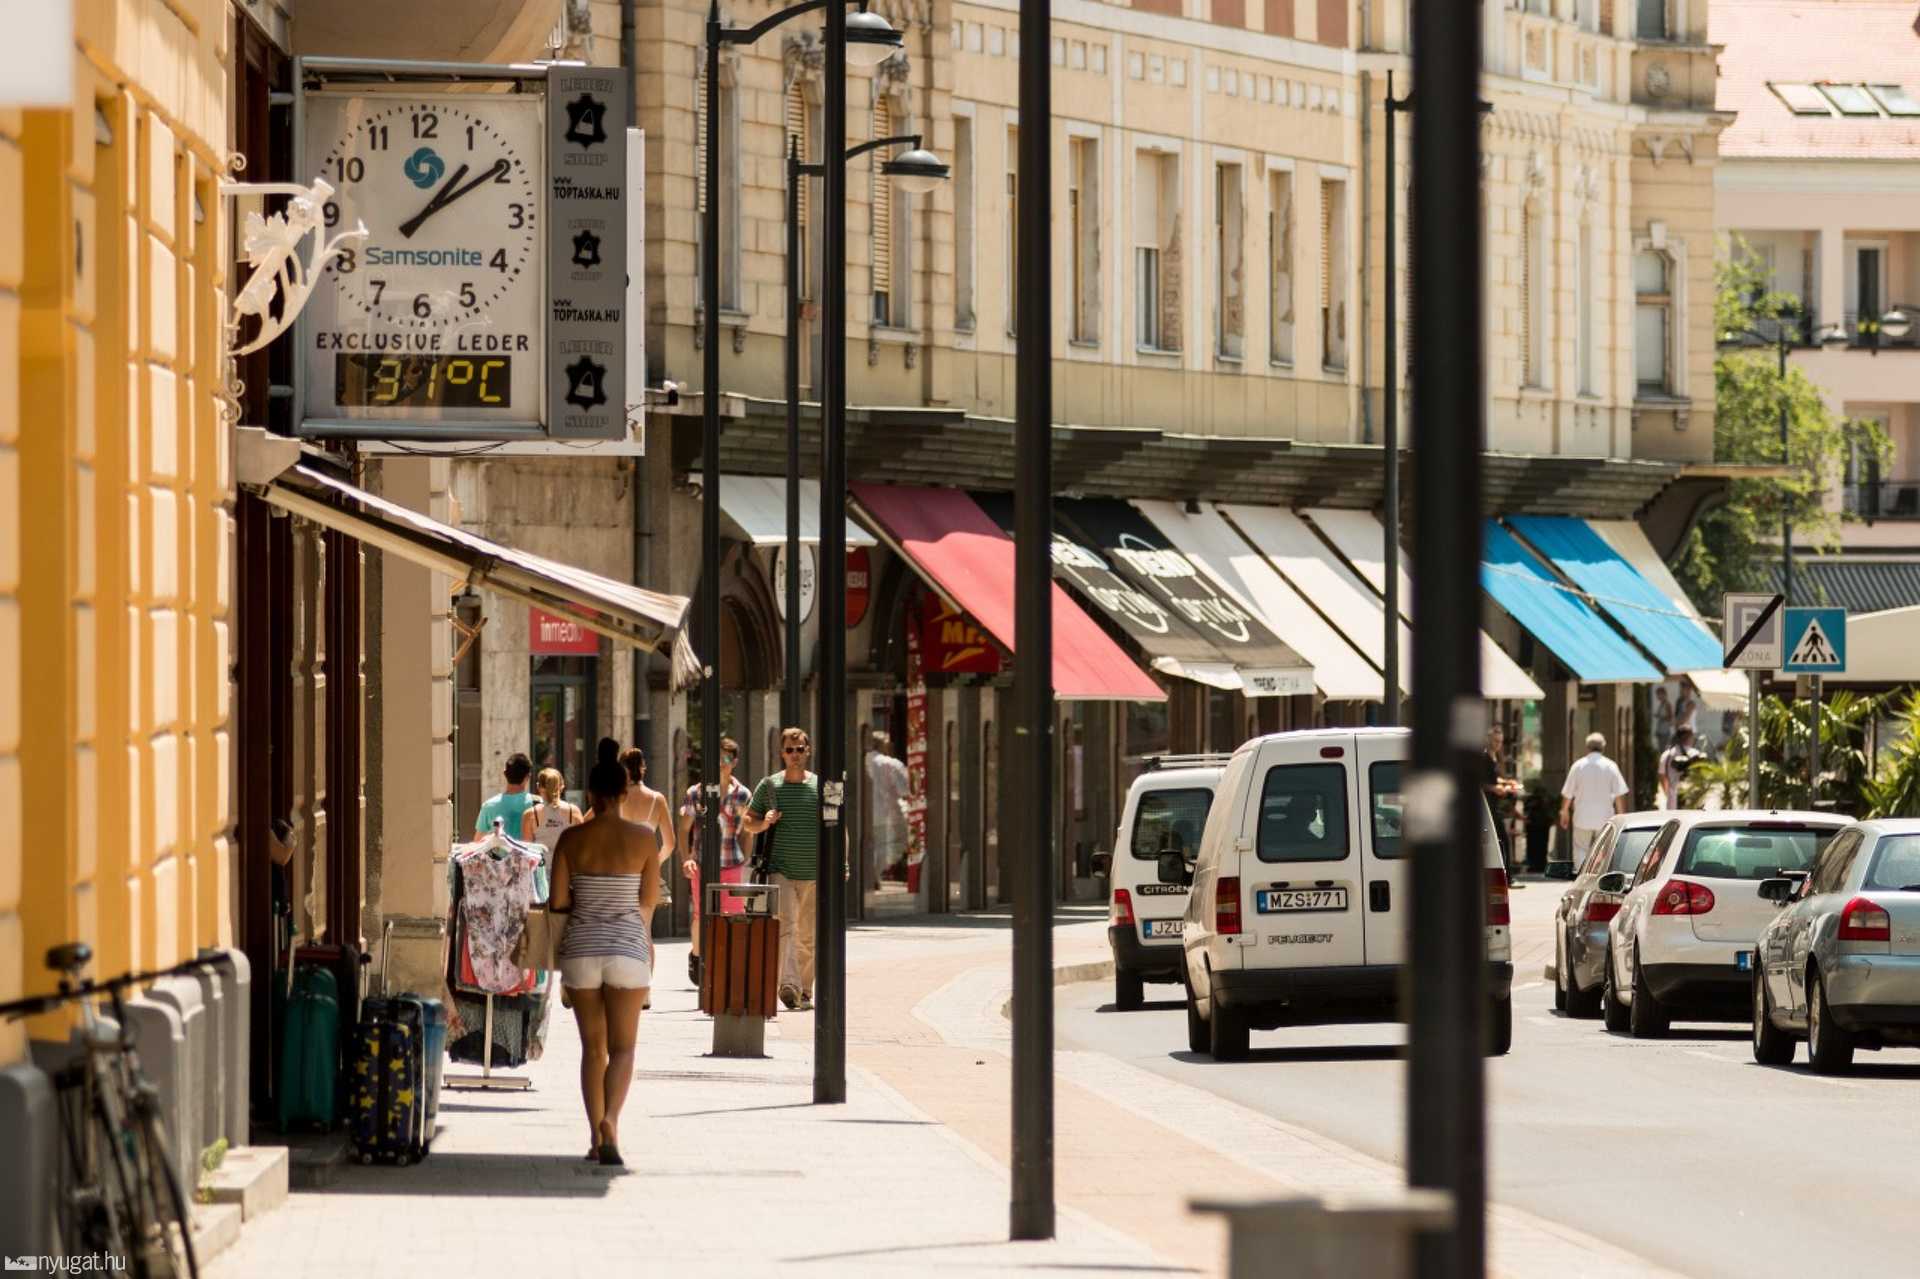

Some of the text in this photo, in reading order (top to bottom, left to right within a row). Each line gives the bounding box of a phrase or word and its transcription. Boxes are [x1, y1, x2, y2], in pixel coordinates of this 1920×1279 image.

[369, 125, 388, 150] 11
[411, 113, 439, 139] 12
[466, 125, 474, 151] 1
[337, 157, 365, 183] 10
[494, 158, 511, 184] 2
[553, 186, 620, 200] TOPTASKA.HU
[322, 202, 340, 228] 9
[508, 203, 524, 229] 3
[336, 248, 356, 274] 8
[365, 247, 483, 266] Samsonite
[489, 248, 508, 274] 4
[370, 280, 386, 306] 7
[413, 294, 432, 318] 6
[459, 283, 476, 308] 5
[553, 309, 620, 322] TOPTASKA.HU
[316, 333, 529, 351] EXCLUSIVE LEDER
